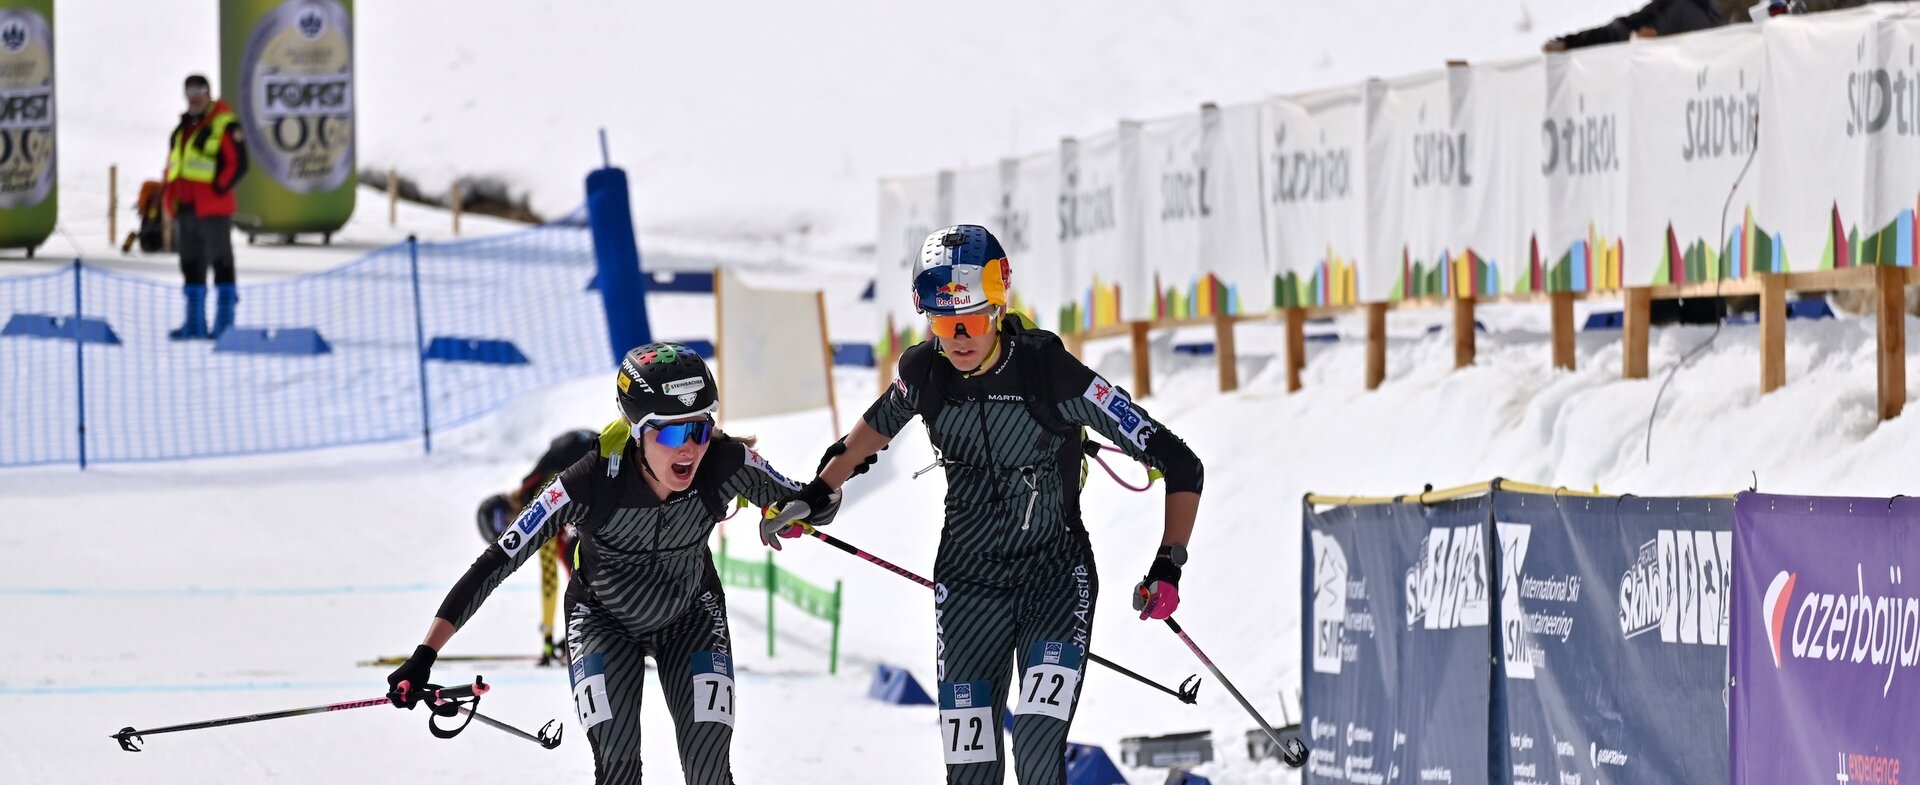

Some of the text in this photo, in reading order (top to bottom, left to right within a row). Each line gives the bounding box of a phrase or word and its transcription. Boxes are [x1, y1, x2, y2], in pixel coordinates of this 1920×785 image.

[266, 80, 346, 108] FORST
[936, 295, 971, 307] Red Bull
[621, 357, 655, 394] DYNAFIT
[1567, 575, 1581, 603] Ski
[1792, 562, 1920, 699] azerbaija
[705, 680, 733, 715] 7.1
[1028, 672, 1065, 706] 7.2
[948, 716, 984, 752] 7.2
